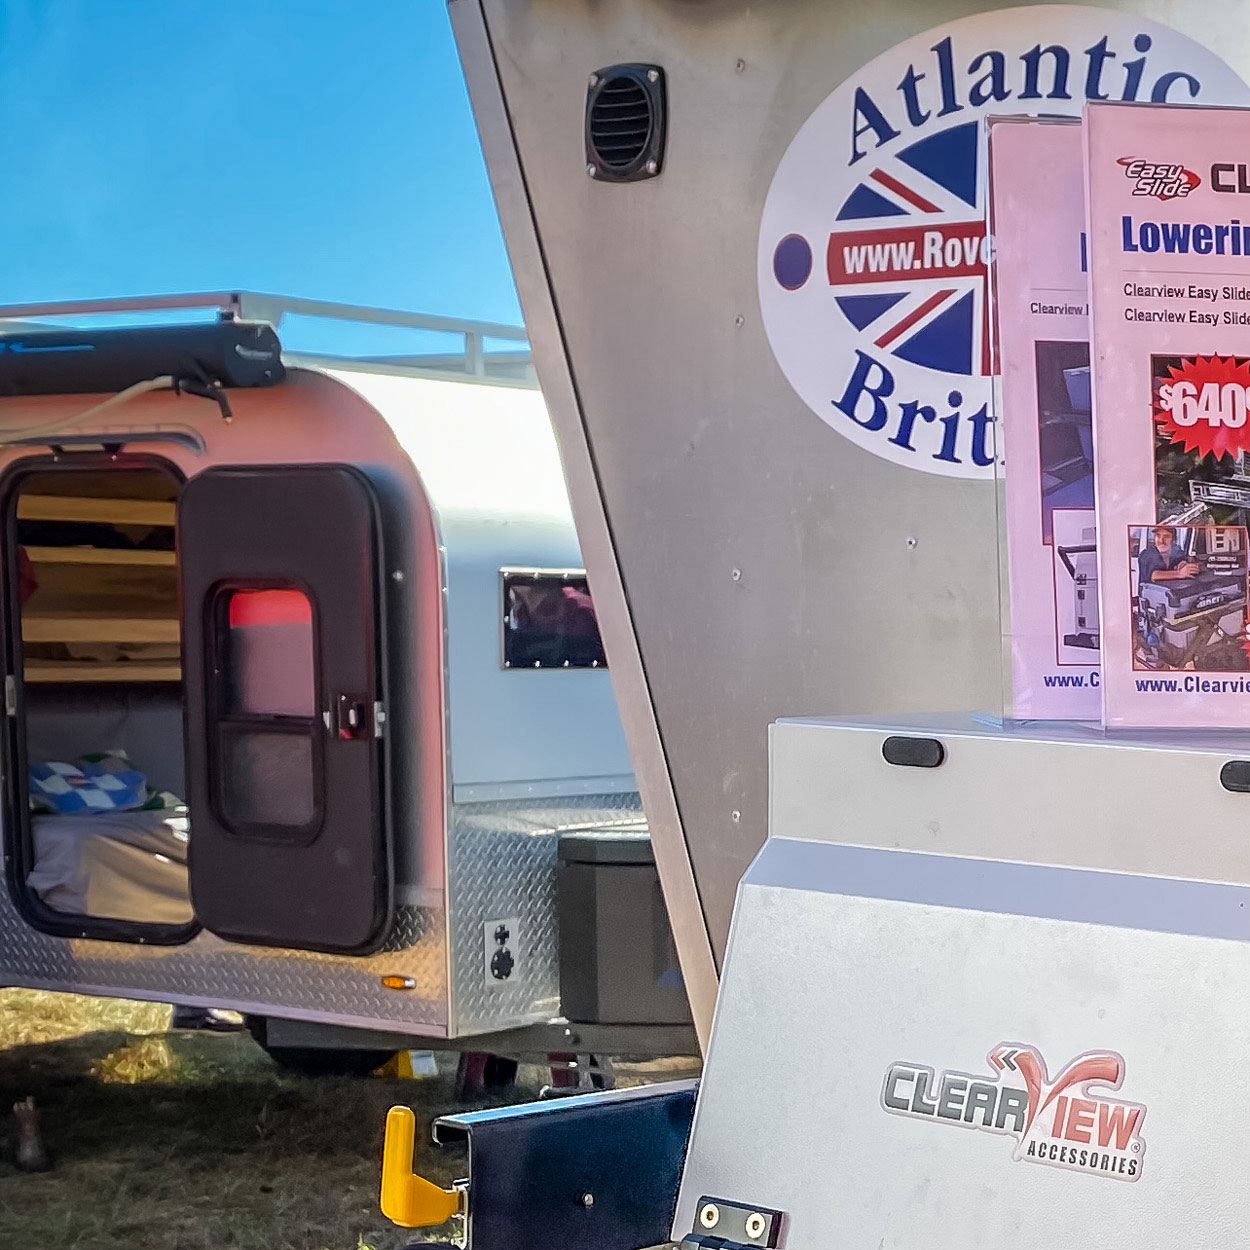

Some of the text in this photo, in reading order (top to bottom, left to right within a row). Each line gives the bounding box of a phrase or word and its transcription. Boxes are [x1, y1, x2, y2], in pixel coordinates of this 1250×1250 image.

[1126, 160, 1184, 182] Easy
[1132, 178, 1192, 197] Slide
[1123, 283, 1185, 298] Clearview
[1188, 286, 1218, 302] Easy
[1031, 302, 1082, 315] Clearview
[1124, 308, 1186, 323] Clearview
[1189, 311, 1219, 326] Easy
[831, 349, 1000, 468] Brit
[1026, 1140, 1139, 1177] ACCESSORIES
